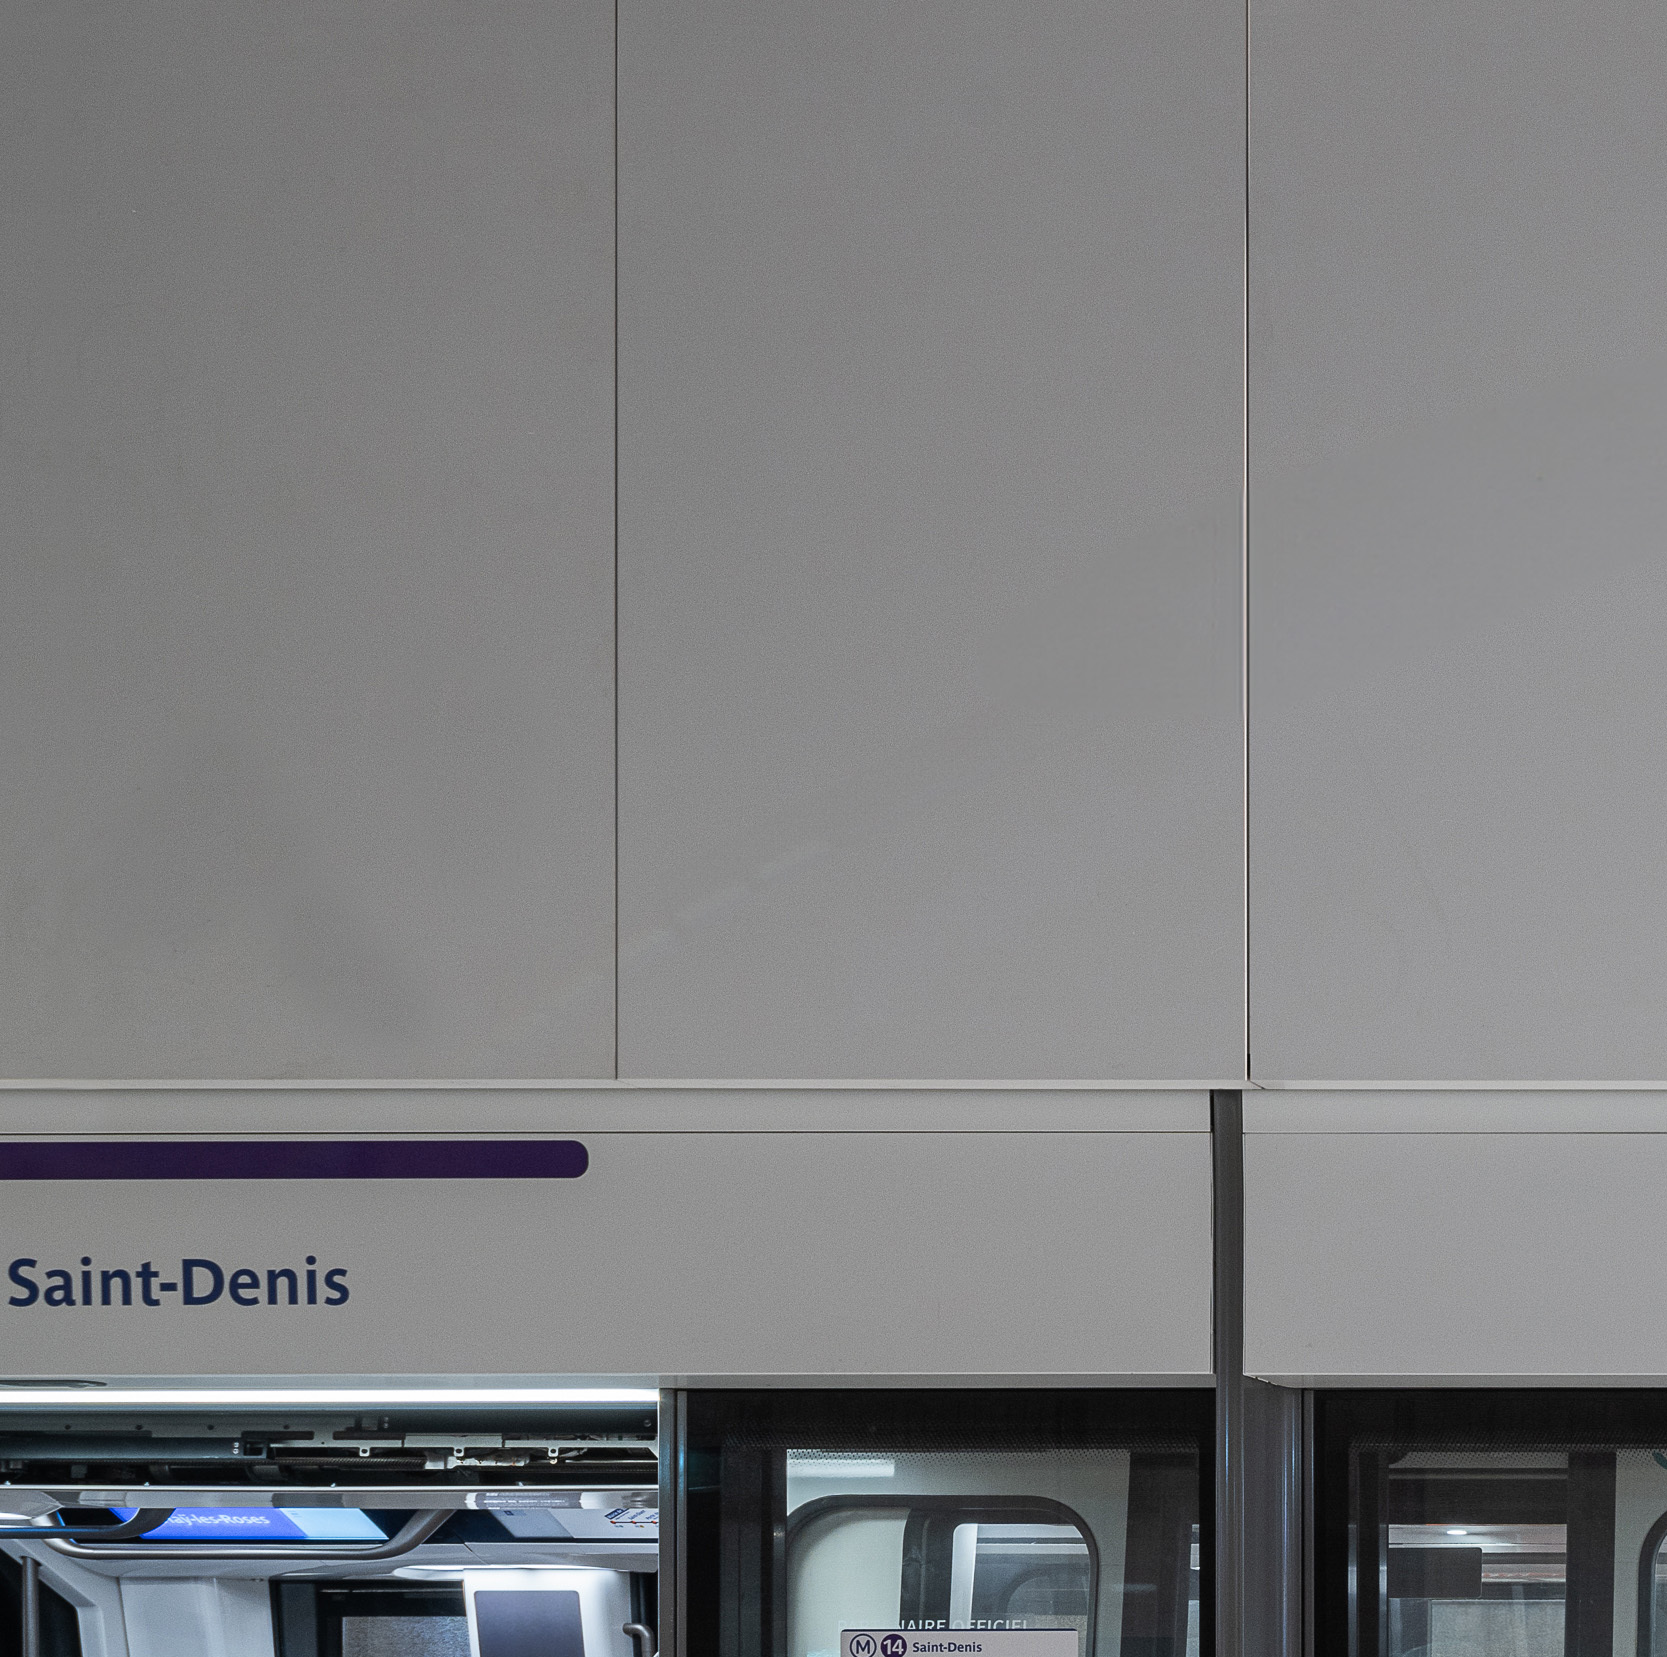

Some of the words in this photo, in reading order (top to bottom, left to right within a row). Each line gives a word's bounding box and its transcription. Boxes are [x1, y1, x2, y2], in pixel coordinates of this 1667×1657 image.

[8, 1254, 350, 1307] Saint-Denis
[882, 1639, 904, 1655] 14
[912, 1641, 982, 1653] Saint-Denis
